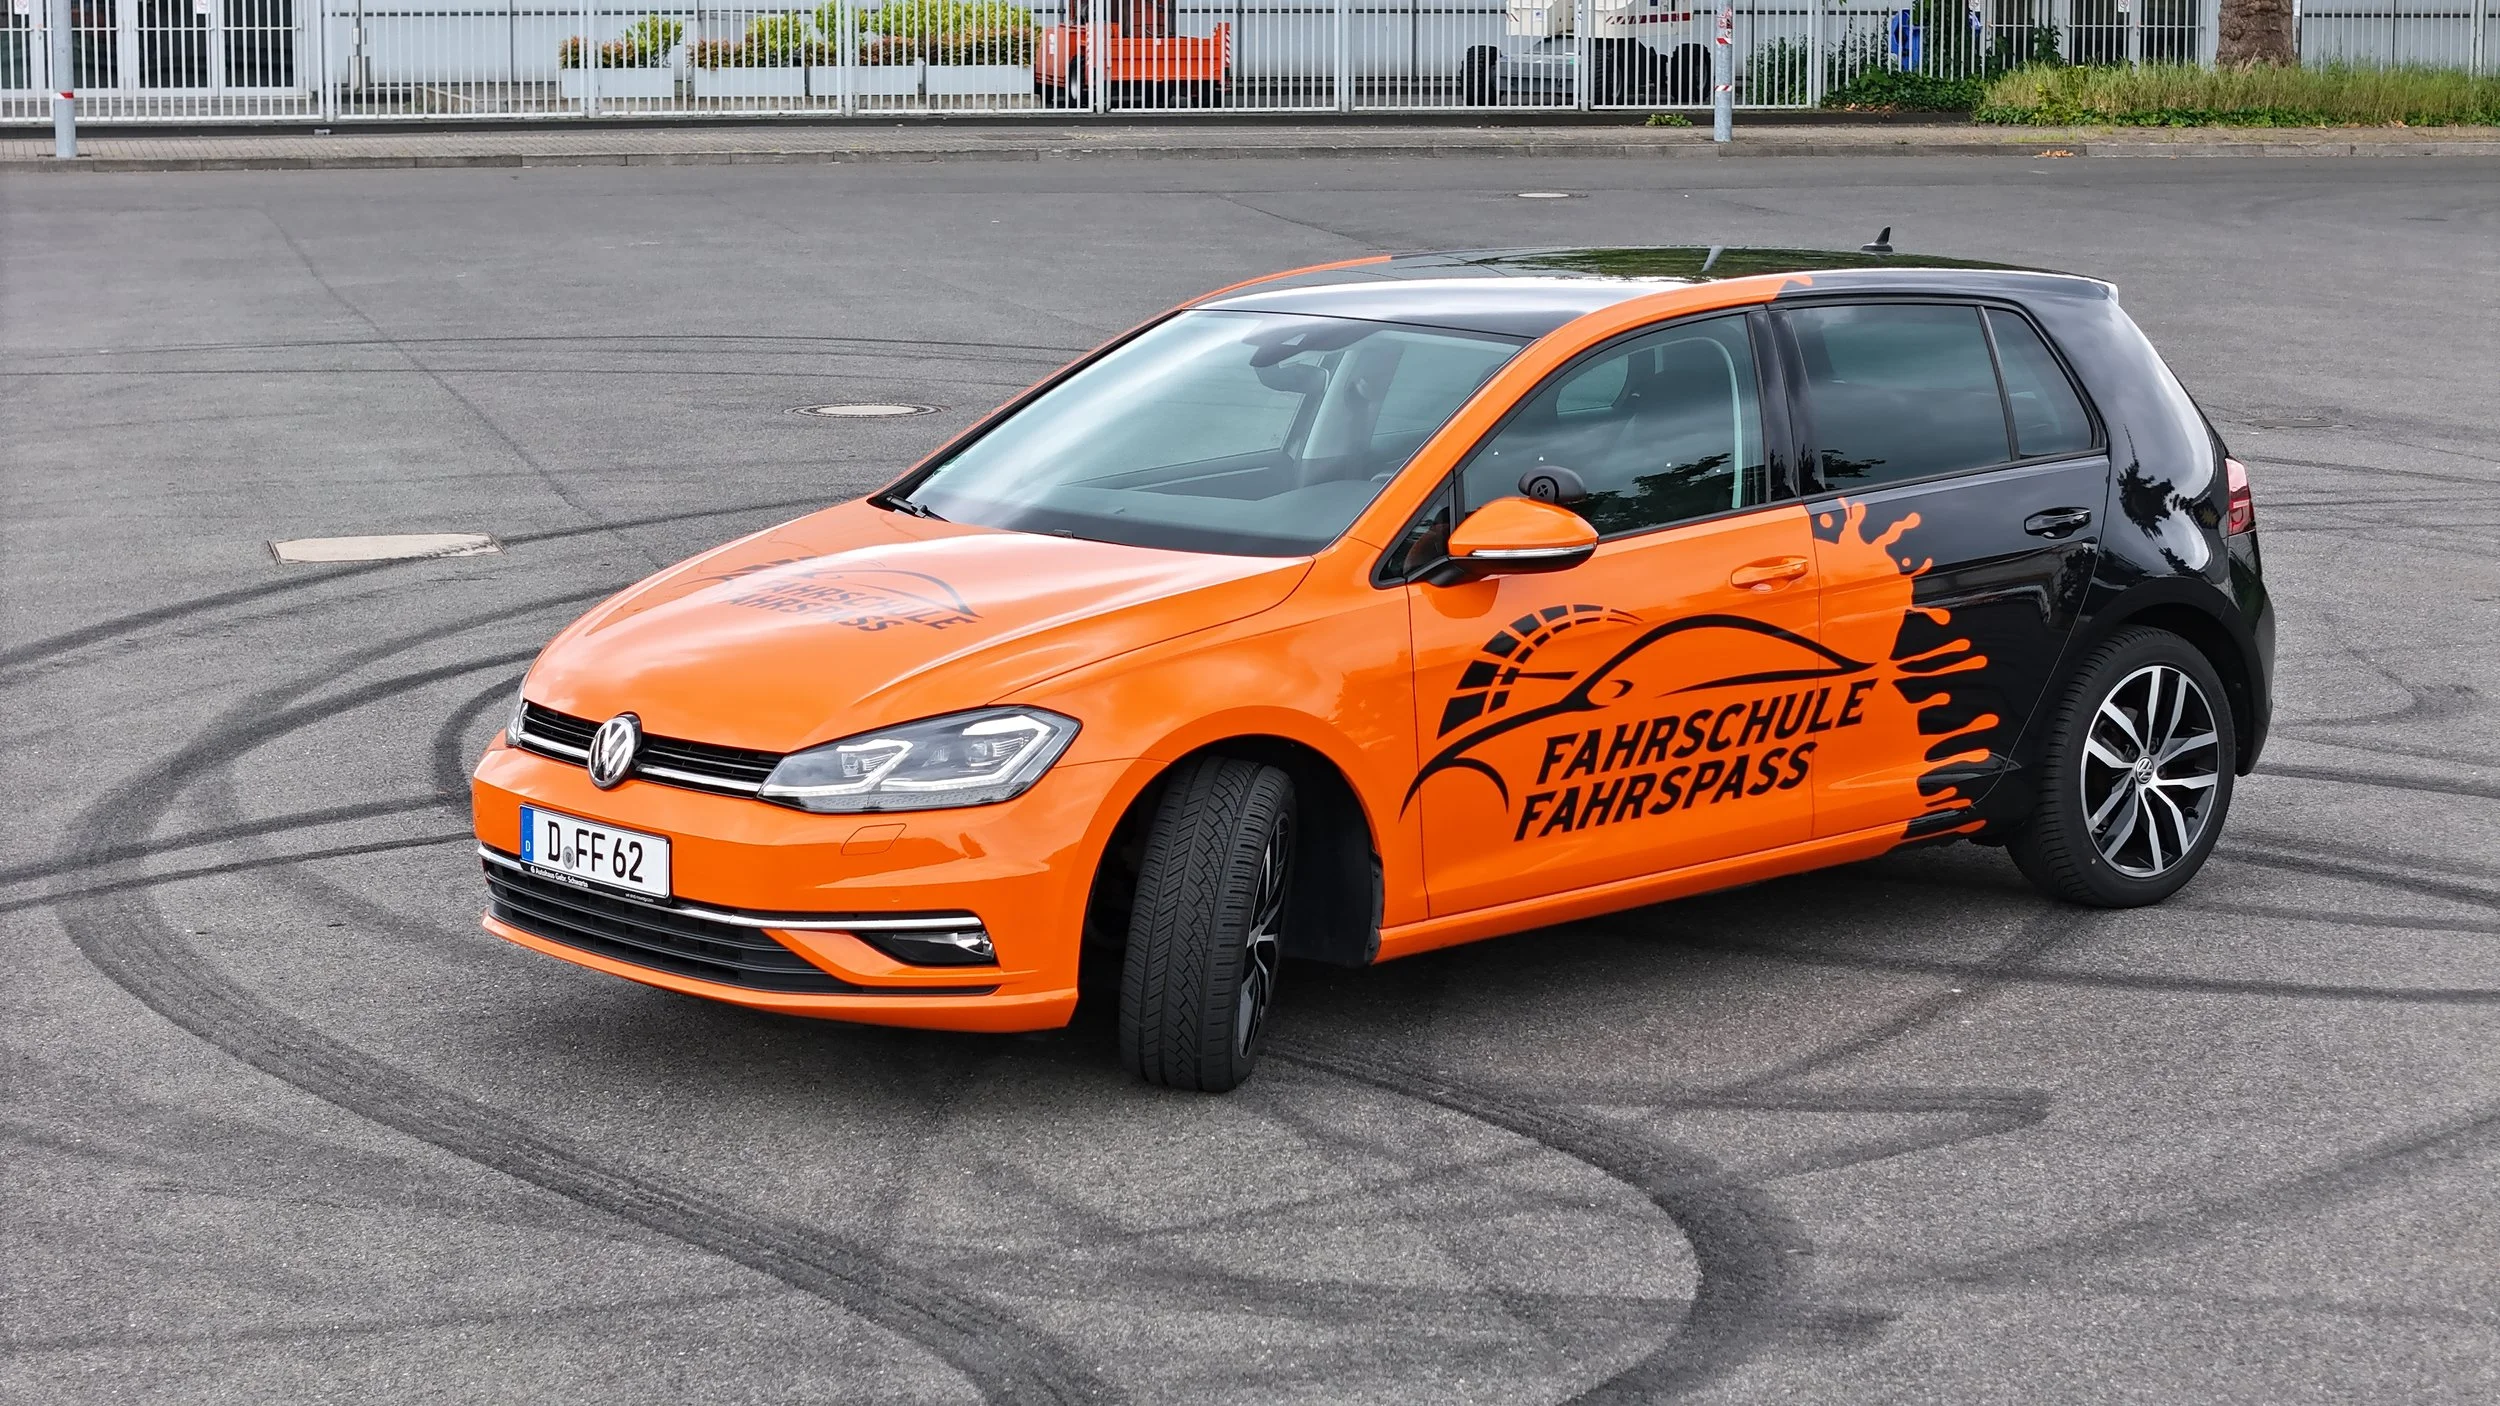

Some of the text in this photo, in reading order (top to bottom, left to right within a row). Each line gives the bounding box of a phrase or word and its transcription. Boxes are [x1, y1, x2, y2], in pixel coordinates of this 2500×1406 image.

[714, 592, 904, 631] AHRSPASS
[1536, 678, 1879, 786] FAHRSCHULE
[1513, 741, 1818, 843] FAHRSPASS
[547, 820, 643, 883] D FF 62
